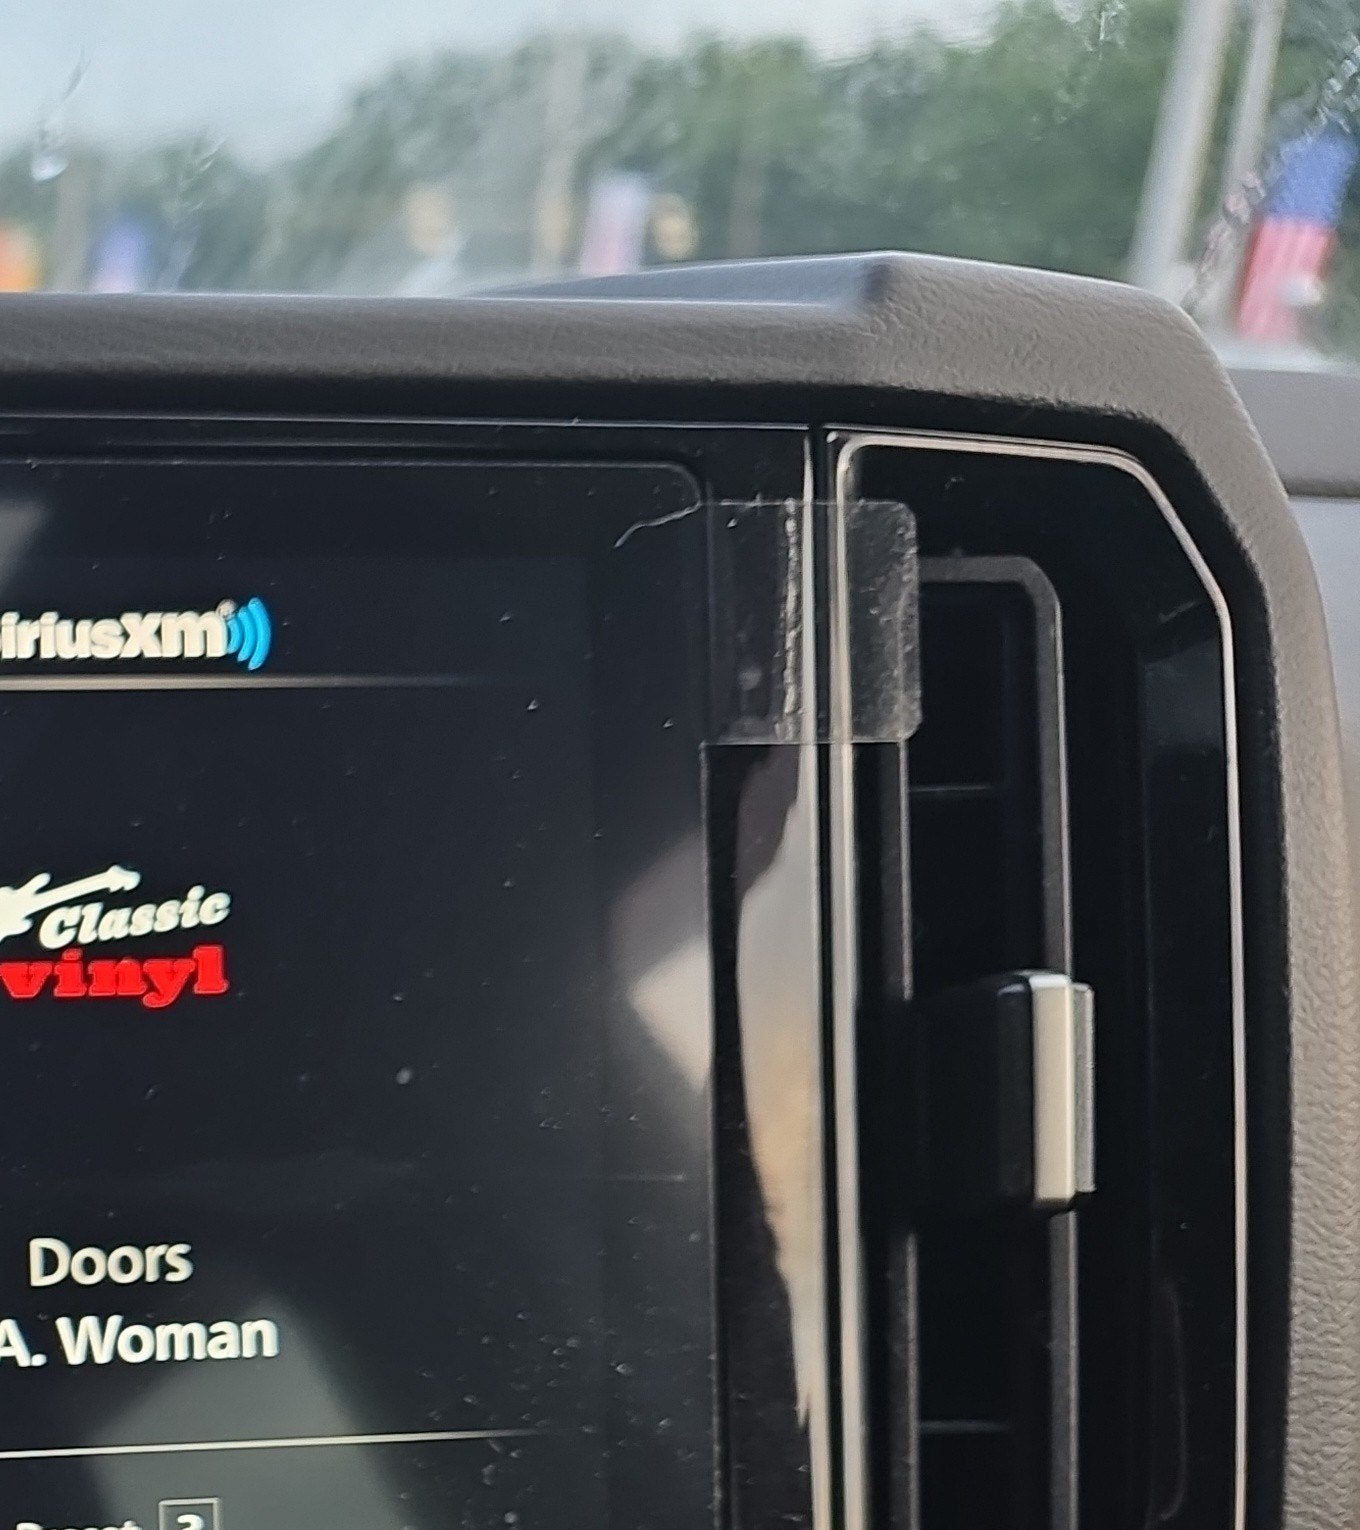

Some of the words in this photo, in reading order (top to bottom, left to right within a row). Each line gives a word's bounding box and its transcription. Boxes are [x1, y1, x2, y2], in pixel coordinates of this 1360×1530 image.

[39, 885, 231, 950] Classic
[28, 1237, 194, 1287] Doors
[55, 1313, 280, 1366] Woman
